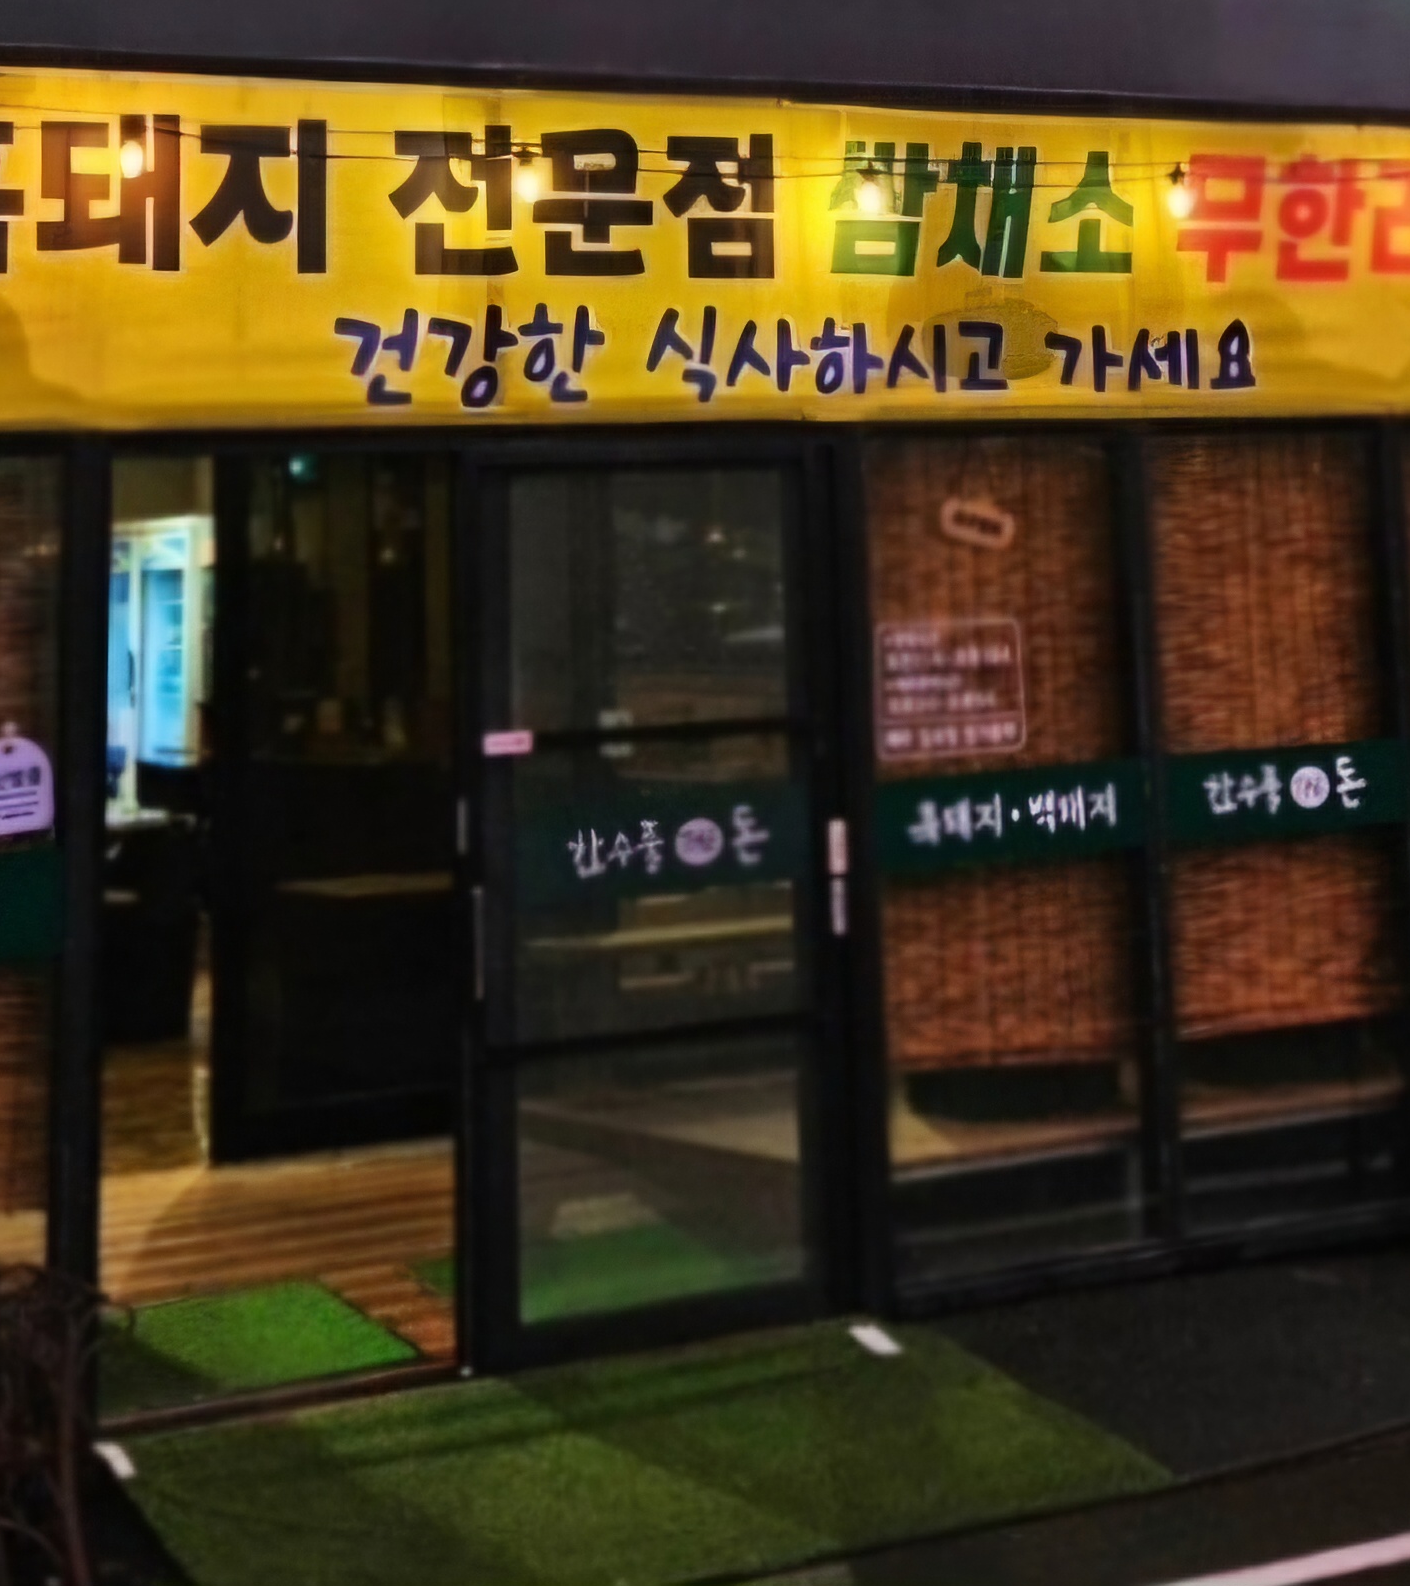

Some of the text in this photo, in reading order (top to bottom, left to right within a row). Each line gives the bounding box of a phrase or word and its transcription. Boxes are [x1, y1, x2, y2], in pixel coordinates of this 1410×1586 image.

[390, 124, 775, 279] 전문점
[829, 141, 1133, 279] 쌈채소
[334, 304, 1257, 408] 건강한 식사하시고 가세요
